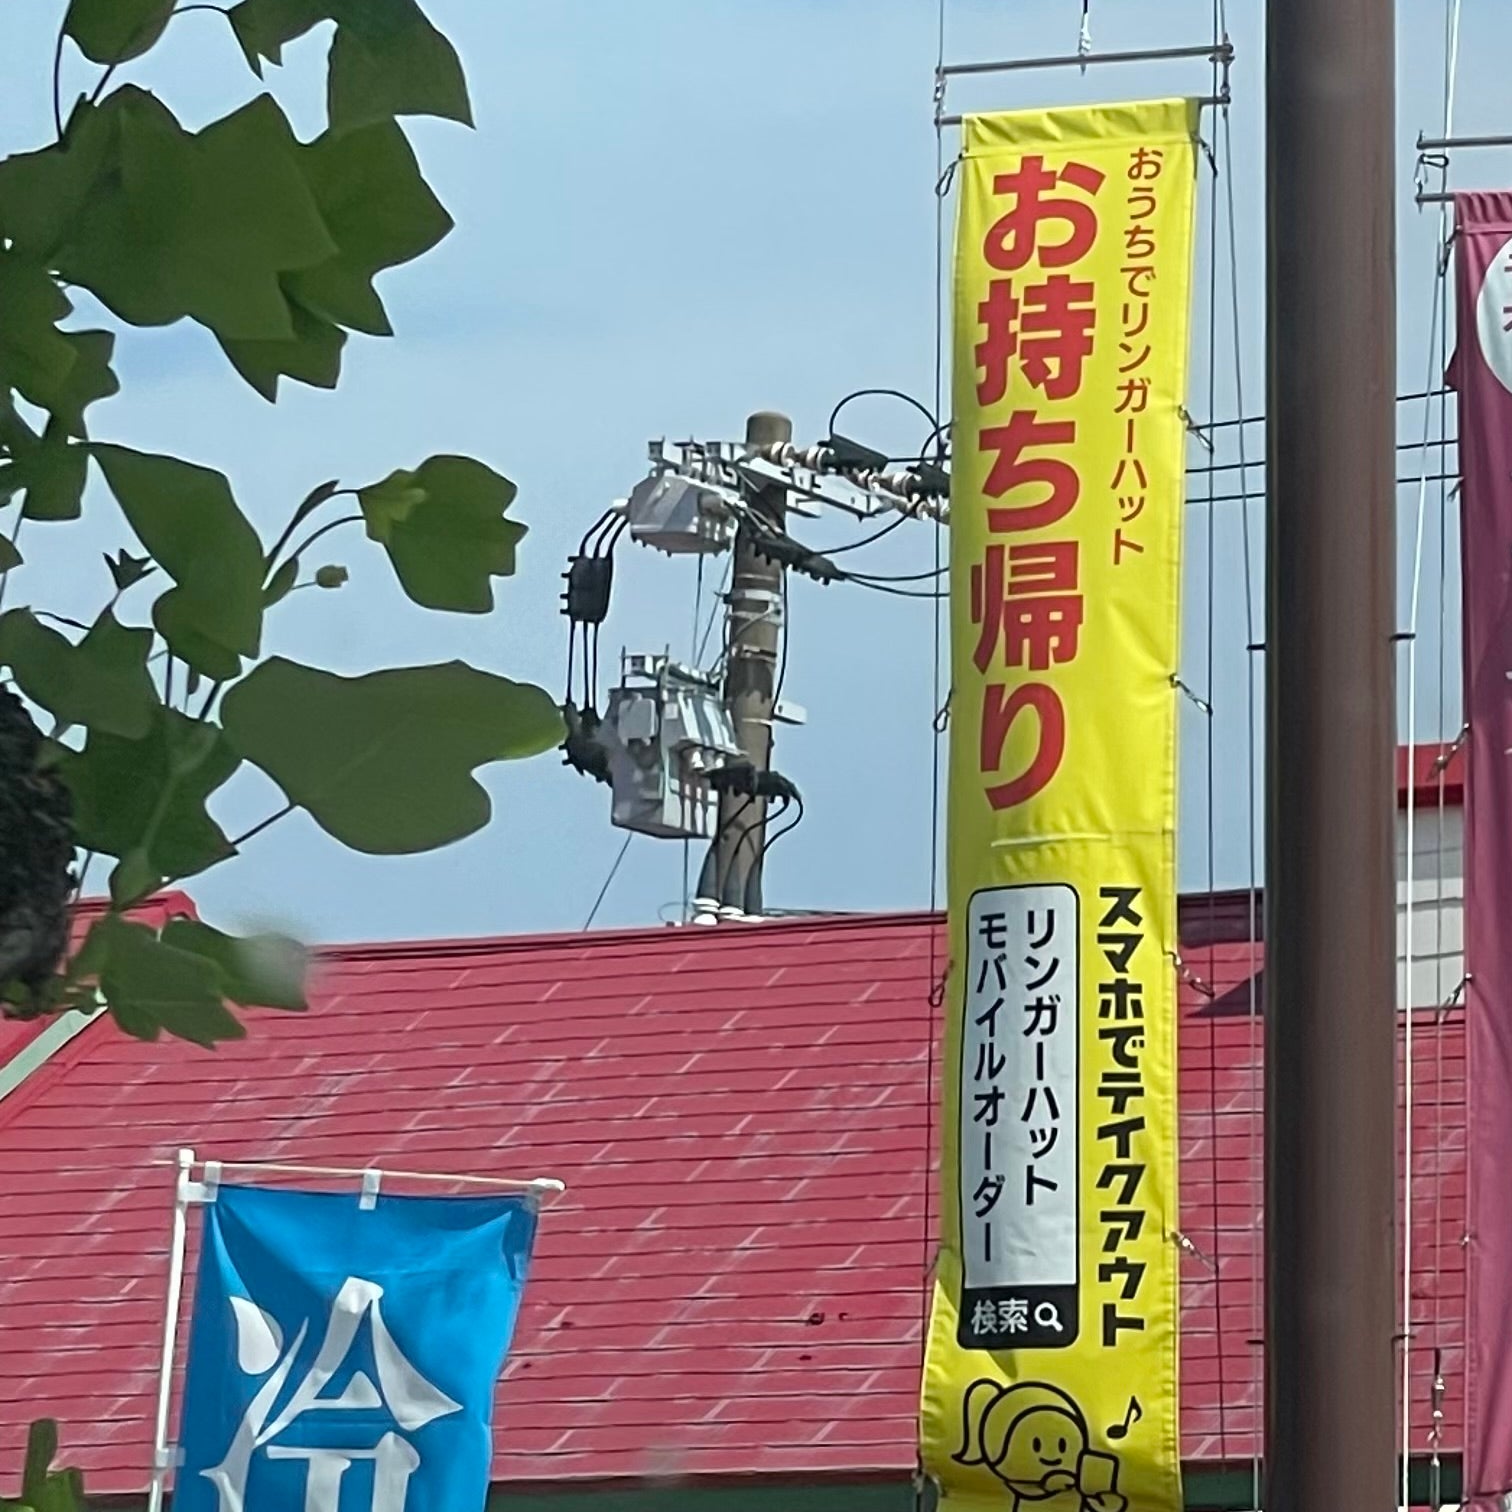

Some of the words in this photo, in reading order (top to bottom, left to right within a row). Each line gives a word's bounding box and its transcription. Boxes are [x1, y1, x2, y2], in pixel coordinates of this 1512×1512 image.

[969, 155, 1106, 812] お持ち帰り
[1110, 147, 1164, 566] おうちでリンガーハット
[971, 912, 1008, 1262] モバイルオーダー
[1020, 909, 1060, 1206] リンガーハット
[1096, 887, 1147, 1348] スマホでテイクアウト
[970, 1297, 1029, 1335] 検索
